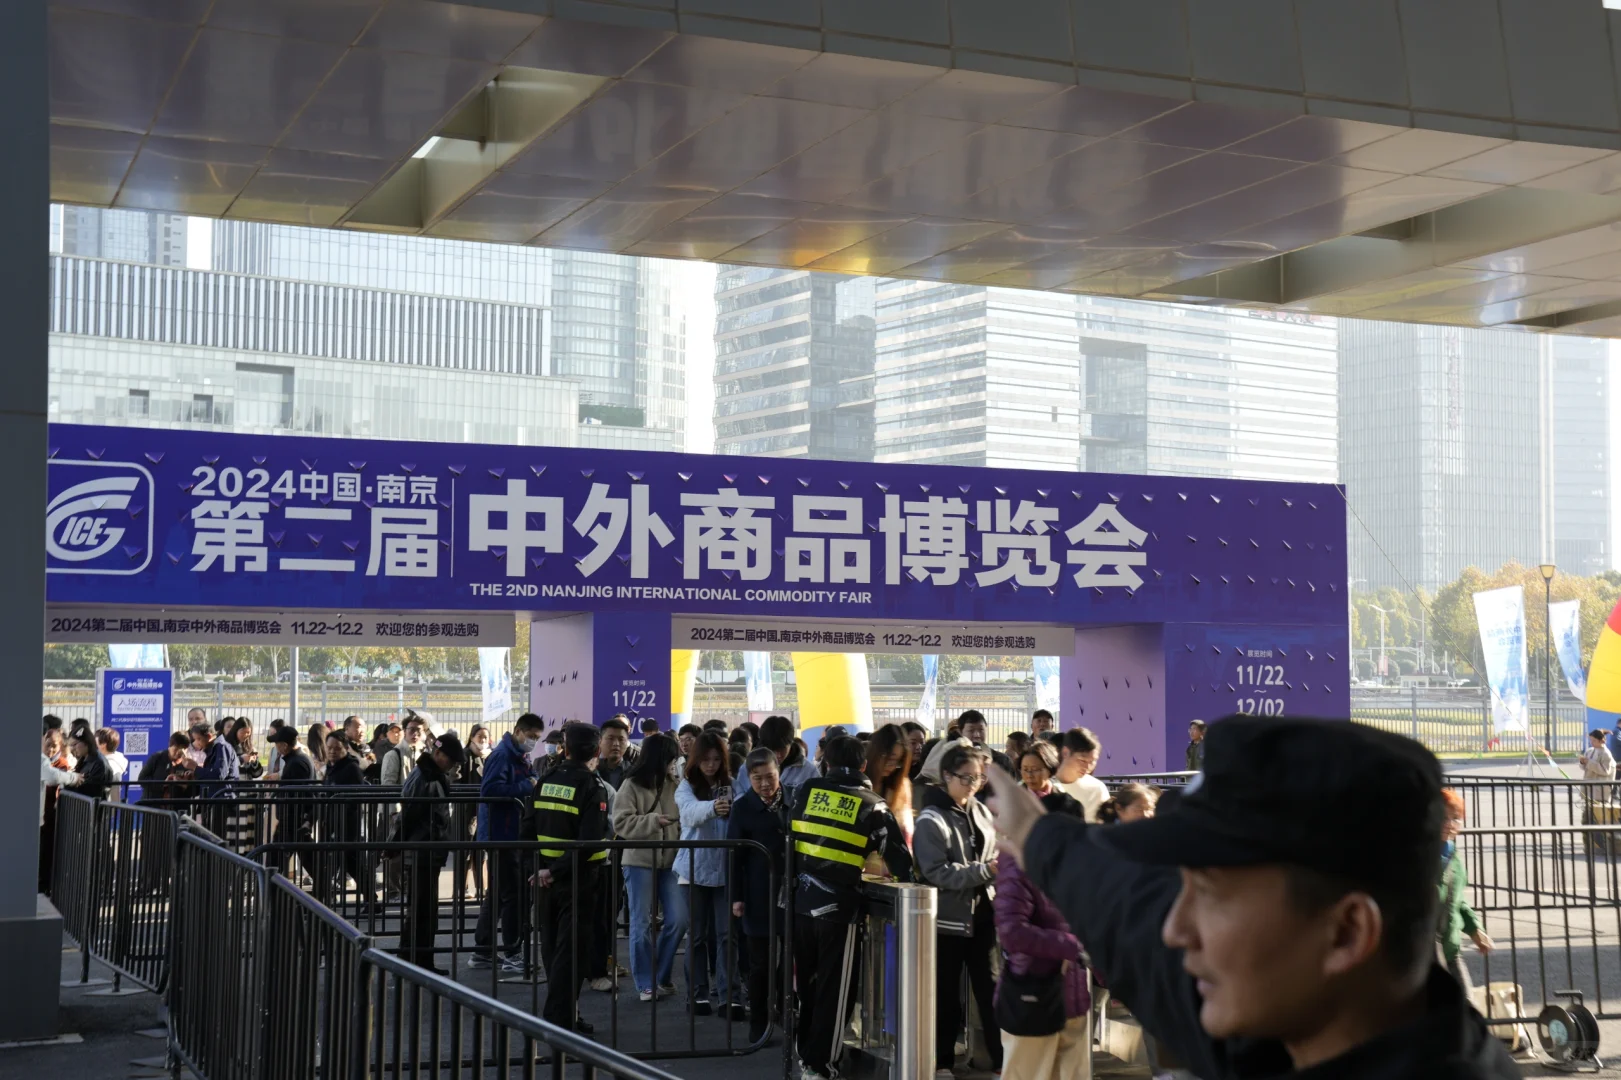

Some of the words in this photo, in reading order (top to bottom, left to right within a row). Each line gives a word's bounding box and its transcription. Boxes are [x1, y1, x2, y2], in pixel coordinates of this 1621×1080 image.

[190, 500, 438, 577] 第二届
[468, 478, 1148, 591] 中外商品博览会
[469, 583, 503, 596] THE
[506, 584, 538, 597] 2ND
[541, 585, 613, 598] NANJING
[617, 586, 742, 601] INTERNATIONAL
[744, 589, 836, 603] COMMODITY
[839, 591, 872, 604] FAIR
[290, 621, 363, 636] 11.22~12.2
[375, 622, 480, 637] 欢迎您的参观选购
[882, 633, 942, 647] 11.22~12.2
[951, 635, 1036, 649] 欢迎您的参观选购
[1236, 665, 1285, 686] 11/22
[612, 690, 656, 707] 11/22
[1236, 698, 1285, 717] 12/02
[810, 804, 853, 818] ZHIQIN
[812, 791, 857, 812] 执勤
